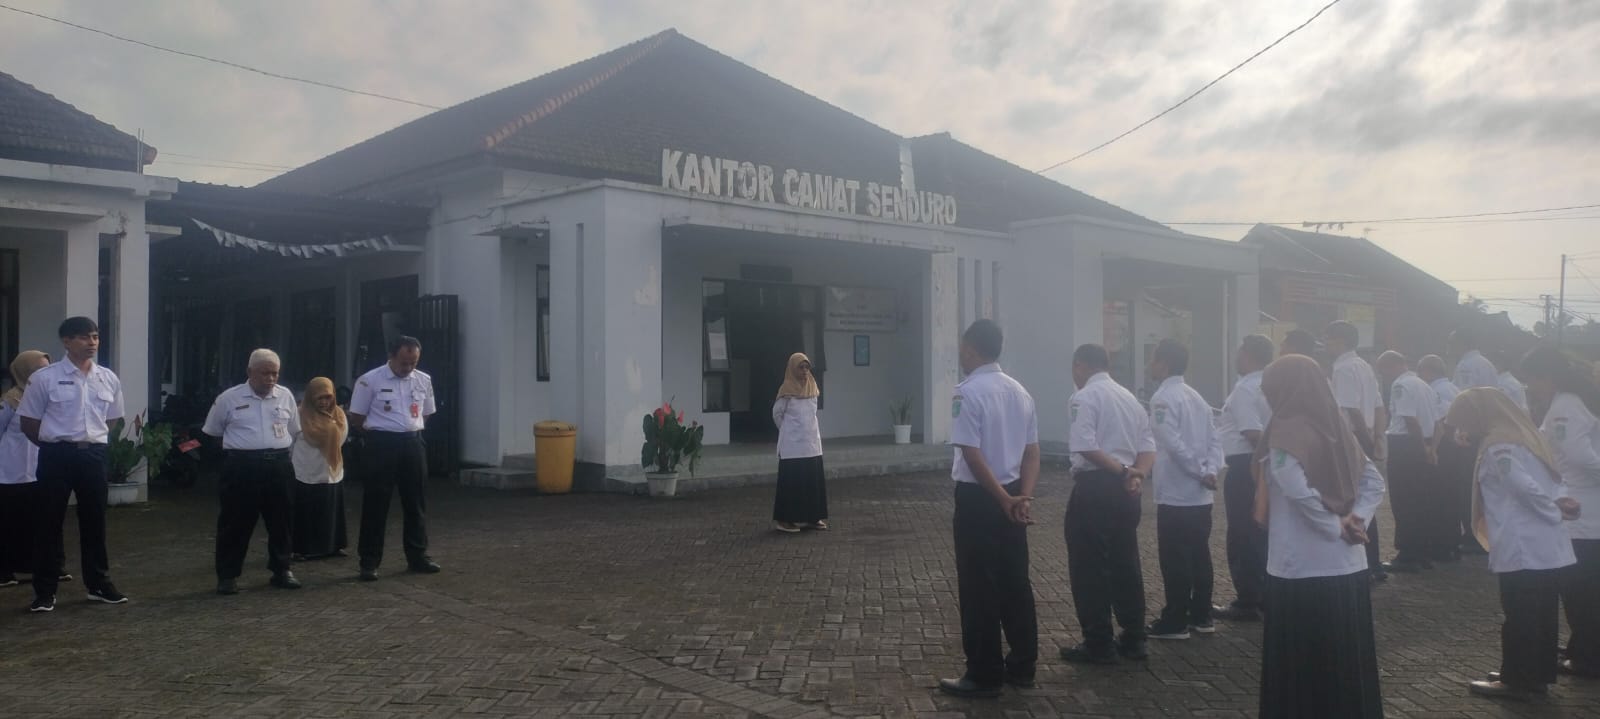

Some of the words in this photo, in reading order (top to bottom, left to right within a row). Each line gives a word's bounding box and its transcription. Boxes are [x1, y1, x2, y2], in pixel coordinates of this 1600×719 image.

[662, 149, 774, 202] KANTOR
[782, 169, 859, 215] CAMAT
[867, 182, 957, 225] SENDURO
